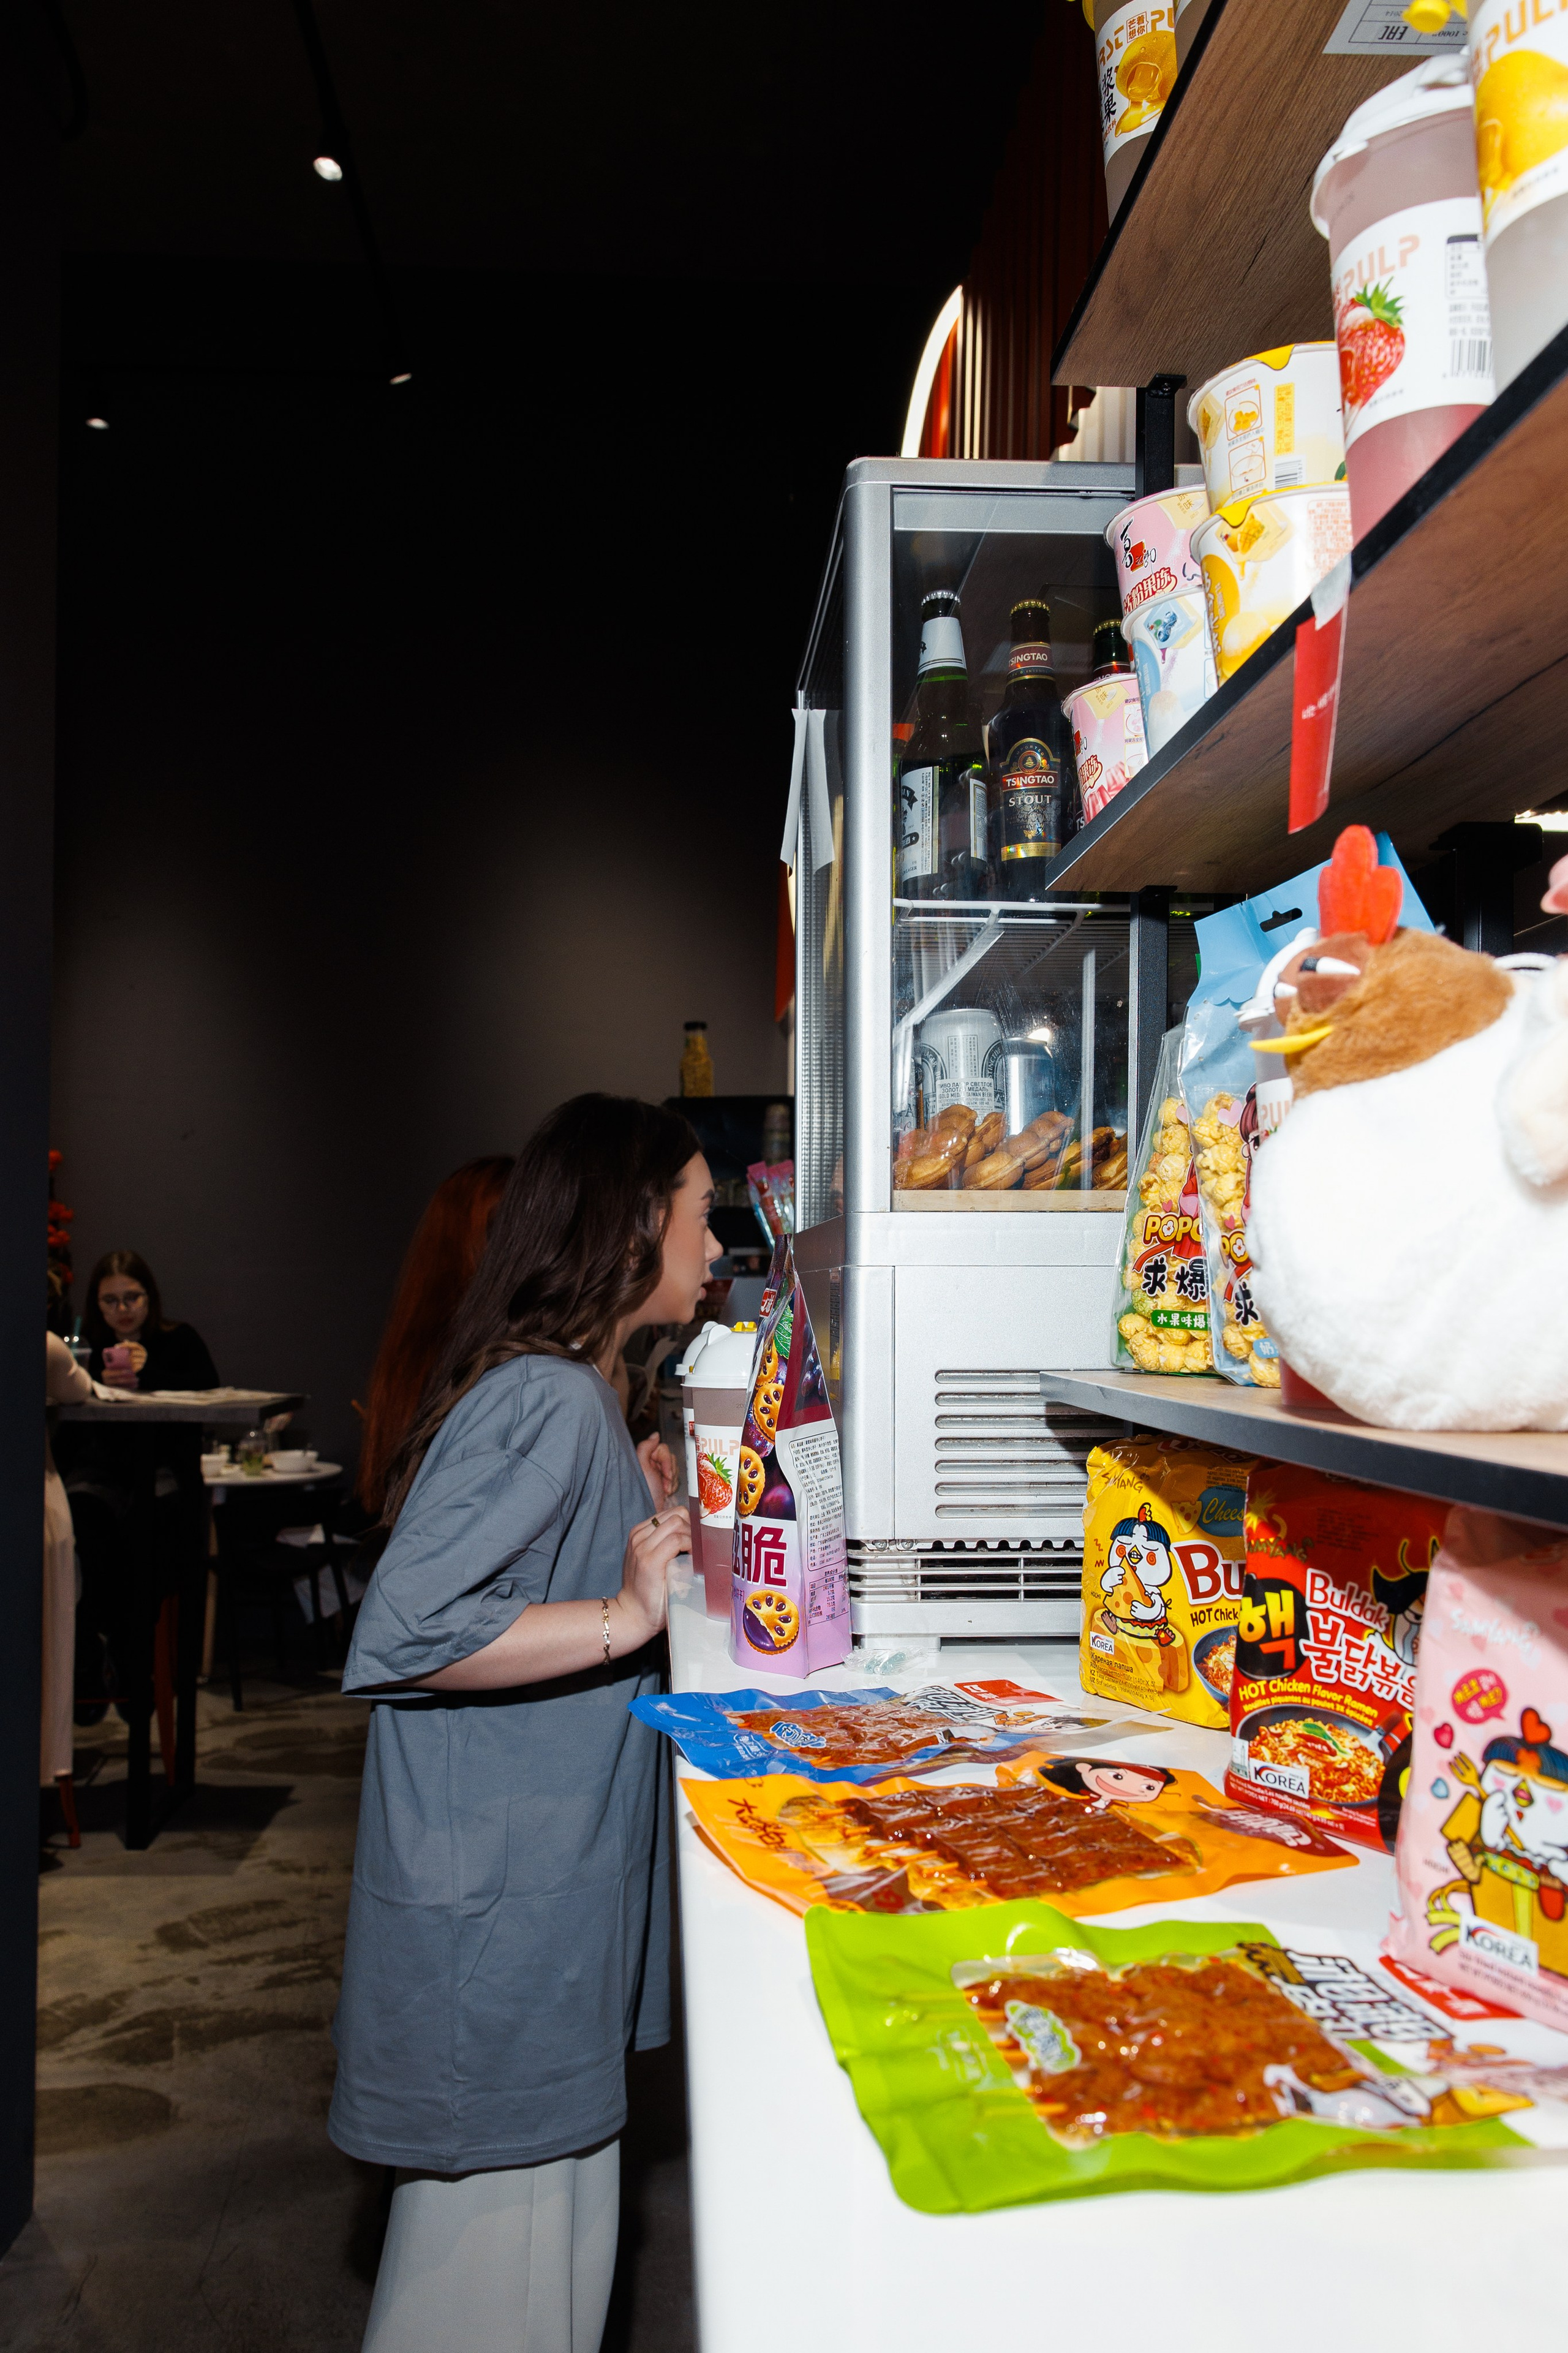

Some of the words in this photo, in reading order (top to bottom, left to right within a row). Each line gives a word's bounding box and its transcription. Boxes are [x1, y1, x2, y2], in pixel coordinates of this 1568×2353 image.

[1378, 25, 1409, 40] EAC
[1485, 0, 1568, 66] PUL
[1344, 234, 1420, 298] PULP
[1009, 652, 1048, 667] TSINGTAO
[1006, 775, 1055, 787] TSINGTAO
[1009, 795, 1052, 807] STOUT
[701, 1438, 740, 1456] PULP
[1310, 1573, 1388, 1626] Buldak
[1190, 1608, 1213, 1627] HOT
[1238, 1590, 1295, 1669] 핵
[1091, 1636, 1114, 1653] KOREA
[1114, 1660, 1134, 1673] лапша
[1238, 1680, 1267, 1701] HOT
[1268, 1677, 1311, 1693] Chicken
[1312, 1684, 1343, 1703] Flavor
[1344, 1694, 1378, 1718] Ramen
[1254, 1767, 1305, 1795] KOREA
[1466, 1925, 1532, 1970] KOREA
